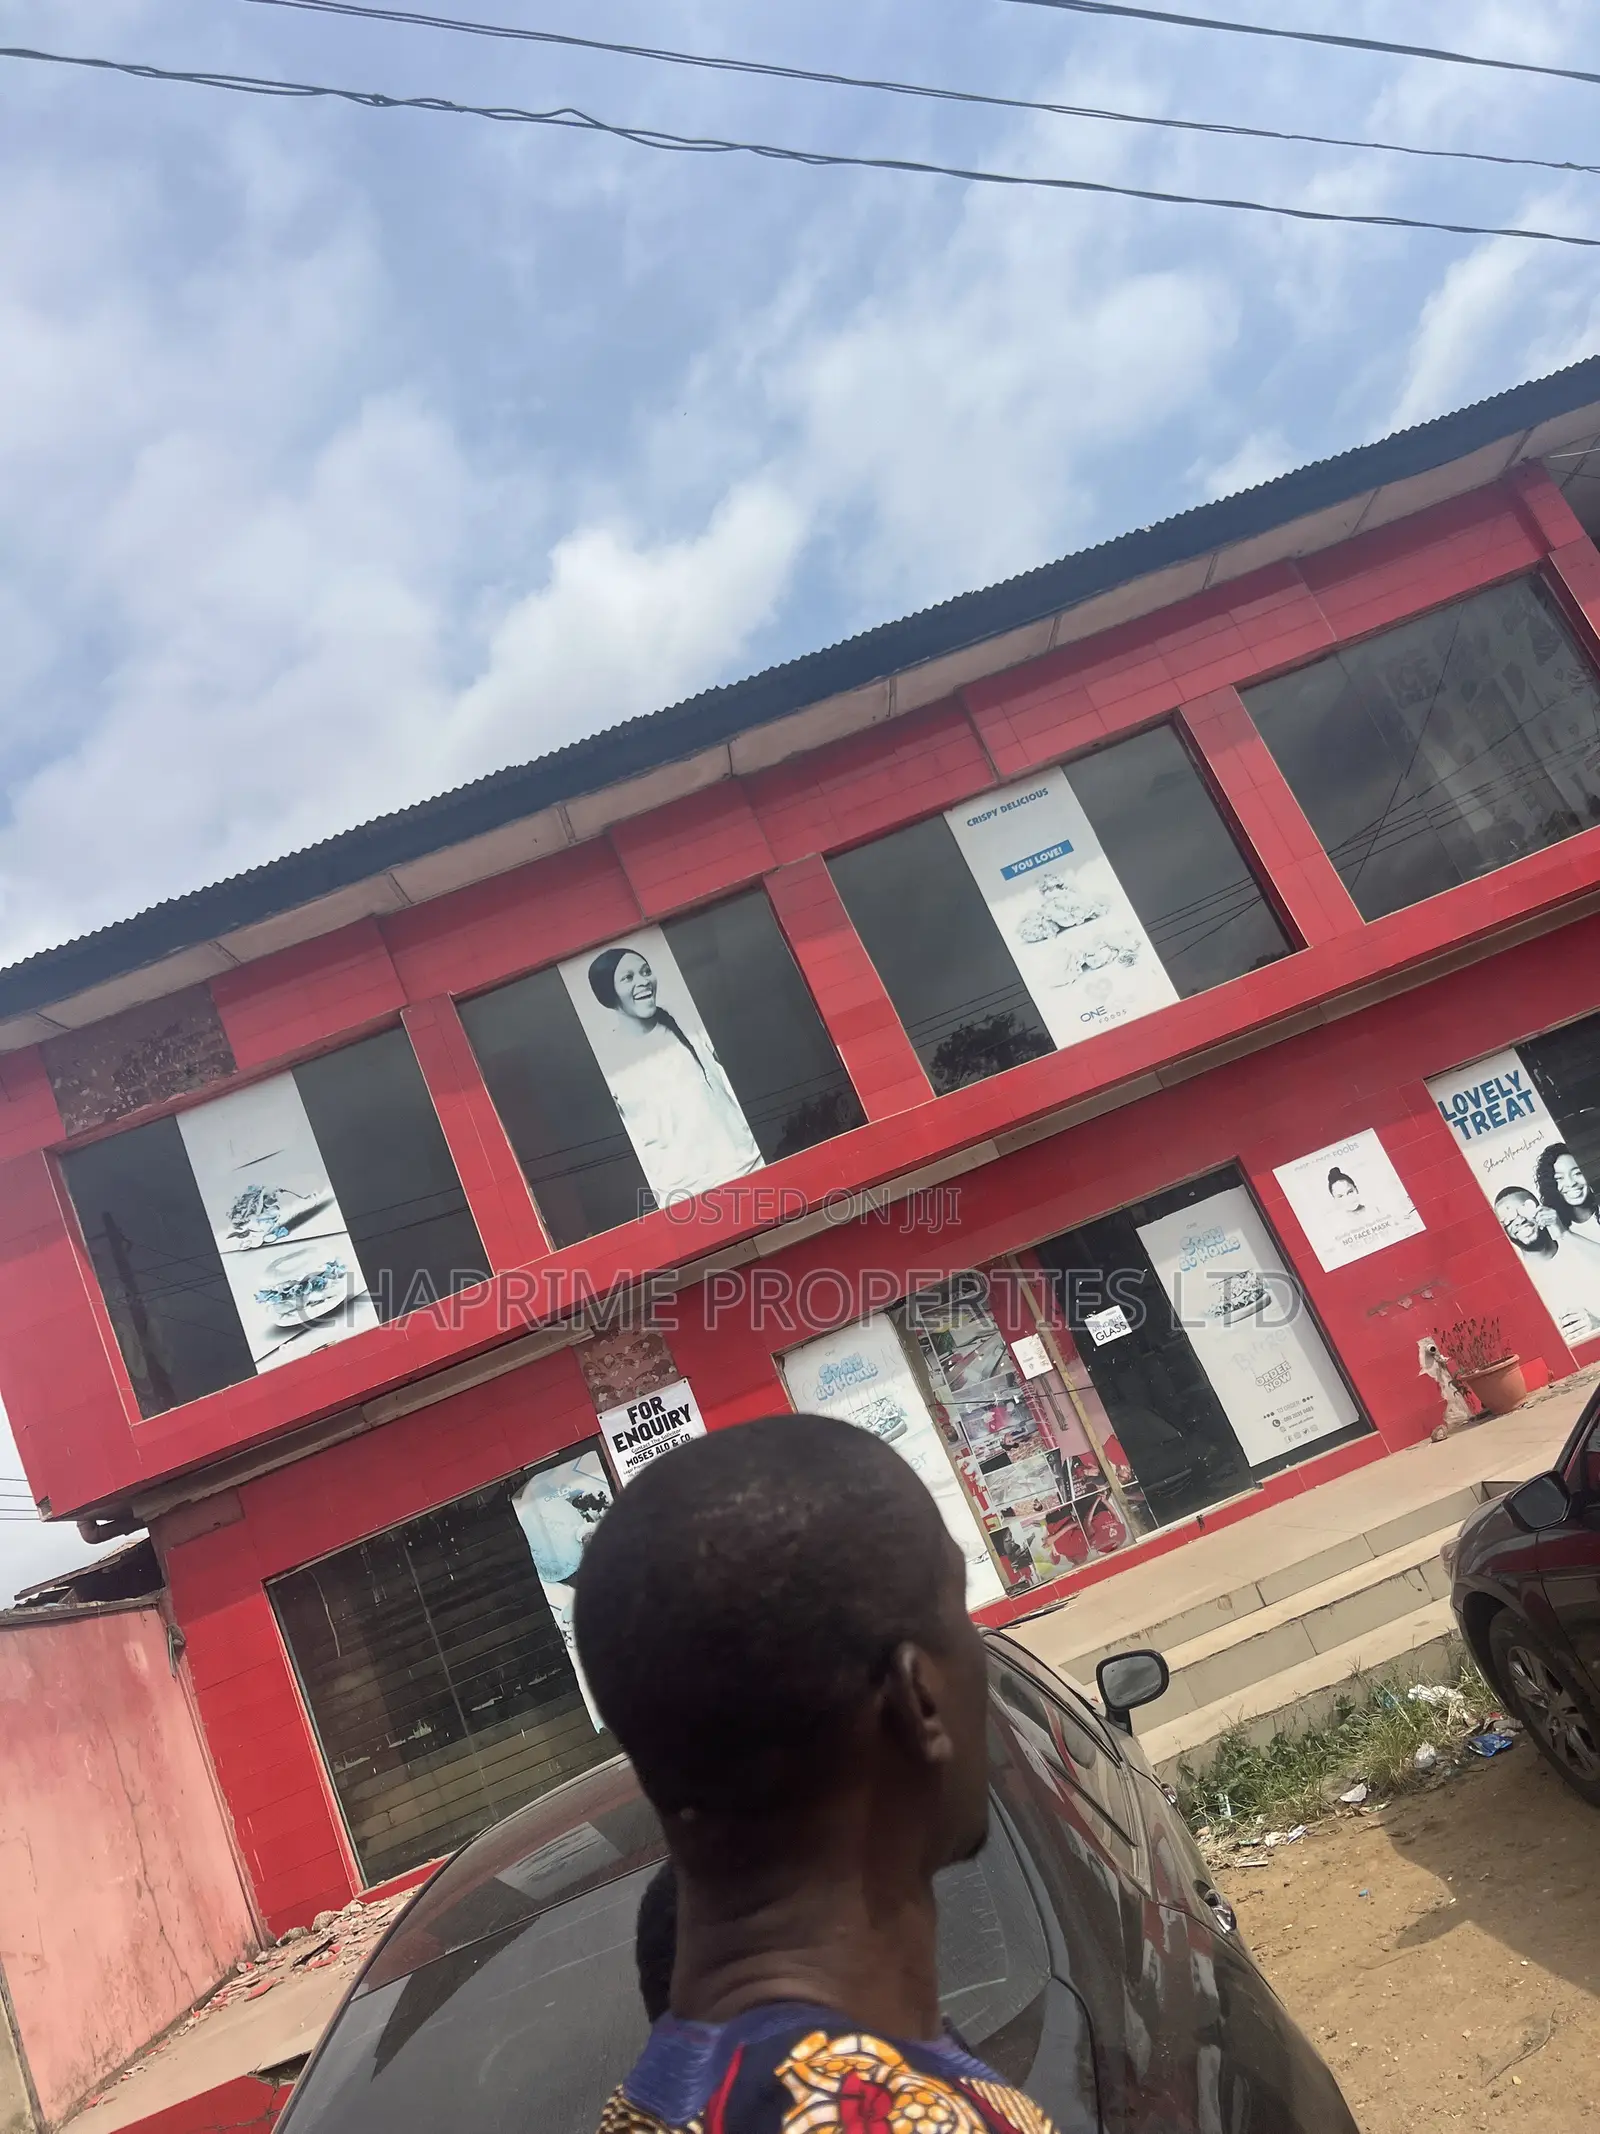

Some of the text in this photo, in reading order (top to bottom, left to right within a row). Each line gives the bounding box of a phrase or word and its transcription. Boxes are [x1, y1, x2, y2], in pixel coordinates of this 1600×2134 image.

[966, 788, 1049, 827] CRISPY DELICIOUS
[1011, 846, 1063, 874] YOU LOVE!
[1079, 1005, 1107, 1023] ONE
[1438, 1069, 1522, 1122] LOVELY
[1452, 1089, 1536, 1140] TREAT
[1342, 1237, 1354, 1247] NO
[1355, 1229, 1371, 1241] FACE
[1371, 1221, 1391, 1234] MASK
[1095, 1321, 1127, 1342] GLASS
[1255, 1360, 1292, 1388] ORDER
[1264, 1372, 1292, 1393] NOW
[627, 1396, 666, 1425] FOR
[612, 1403, 691, 1453] ENQUIRY
[626, 1449, 654, 1468] MOSES
[655, 1442, 670, 1455] ALO
[671, 1438, 679, 1447] &
[631, 1441, 651, 1454] Contact
